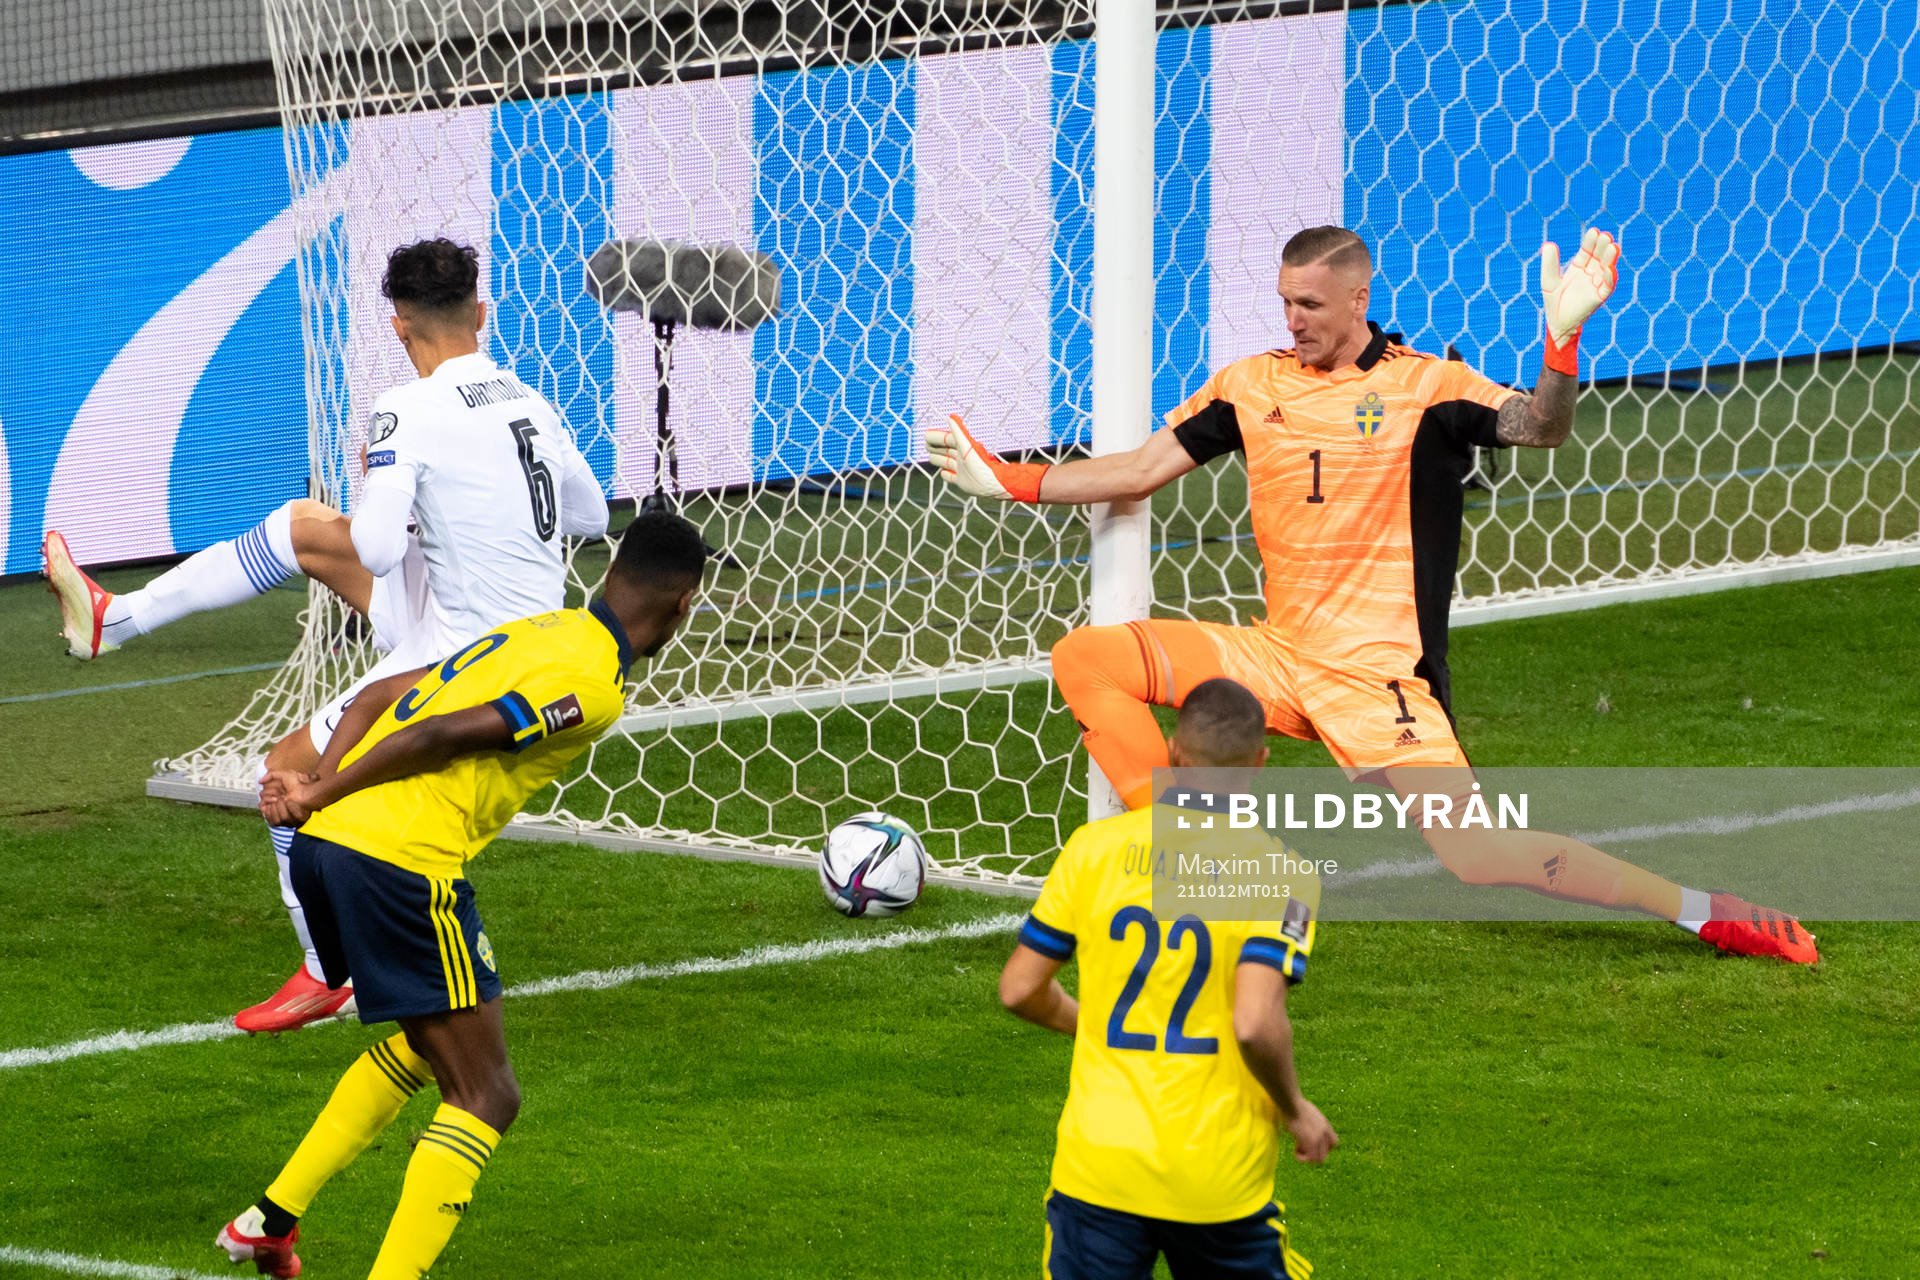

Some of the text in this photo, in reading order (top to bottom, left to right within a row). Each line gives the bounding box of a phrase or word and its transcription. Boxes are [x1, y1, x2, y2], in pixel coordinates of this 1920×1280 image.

[508, 418, 556, 542] 6
[1307, 450, 1324, 503] 1
[394, 633, 509, 721] 9
[1387, 680, 1416, 724] 1
[1107, 905, 1219, 1054] 22
